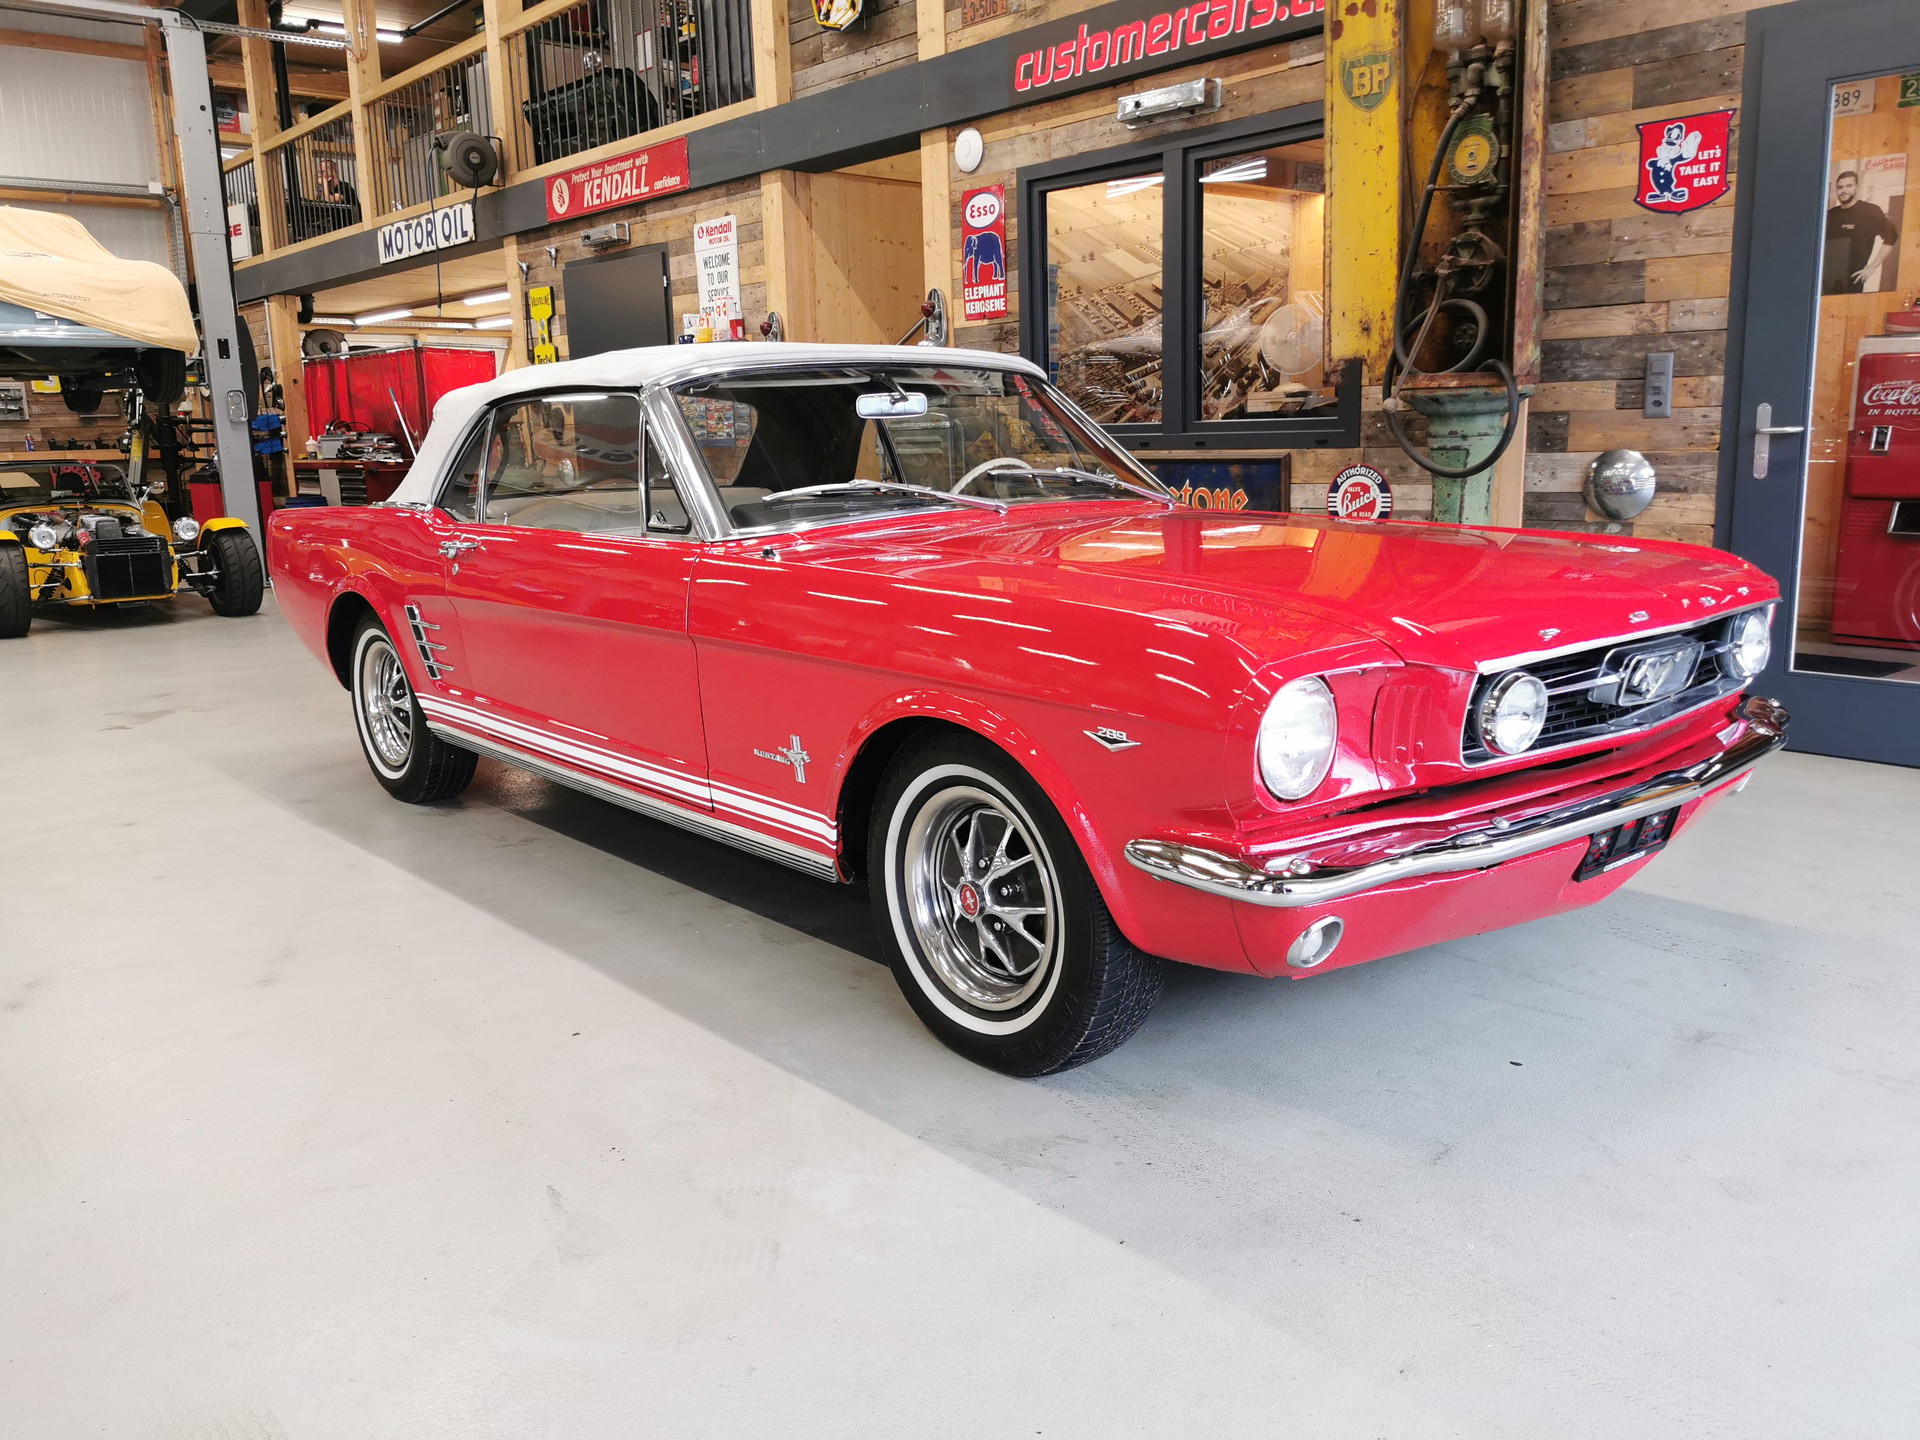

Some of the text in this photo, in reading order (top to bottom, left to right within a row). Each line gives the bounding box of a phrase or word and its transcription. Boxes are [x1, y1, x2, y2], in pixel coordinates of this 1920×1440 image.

[1350, 62, 1390, 98] BP
[1698, 145, 1722, 160] LET'S
[571, 152, 649, 184] Protect Your Investment with
[1679, 161, 1721, 176] TAKE IT
[584, 166, 649, 208] KENDALL
[653, 175, 681, 191] confidence
[1693, 175, 1720, 187] EASY
[970, 204, 996, 219] Esso
[383, 207, 469, 259] MOTOR OIL
[705, 221, 732, 238] Kendall
[703, 252, 730, 270] WELCOME
[707, 270, 729, 286] TO OUR
[964, 283, 1005, 300] ELEPHANT
[965, 298, 1006, 314] KEROSENE
[1868, 408, 1880, 416] IN
[1336, 467, 1383, 486] AUTHORIZED
[1341, 485, 1379, 517] Buick
[1097, 726, 1127, 740] 289
